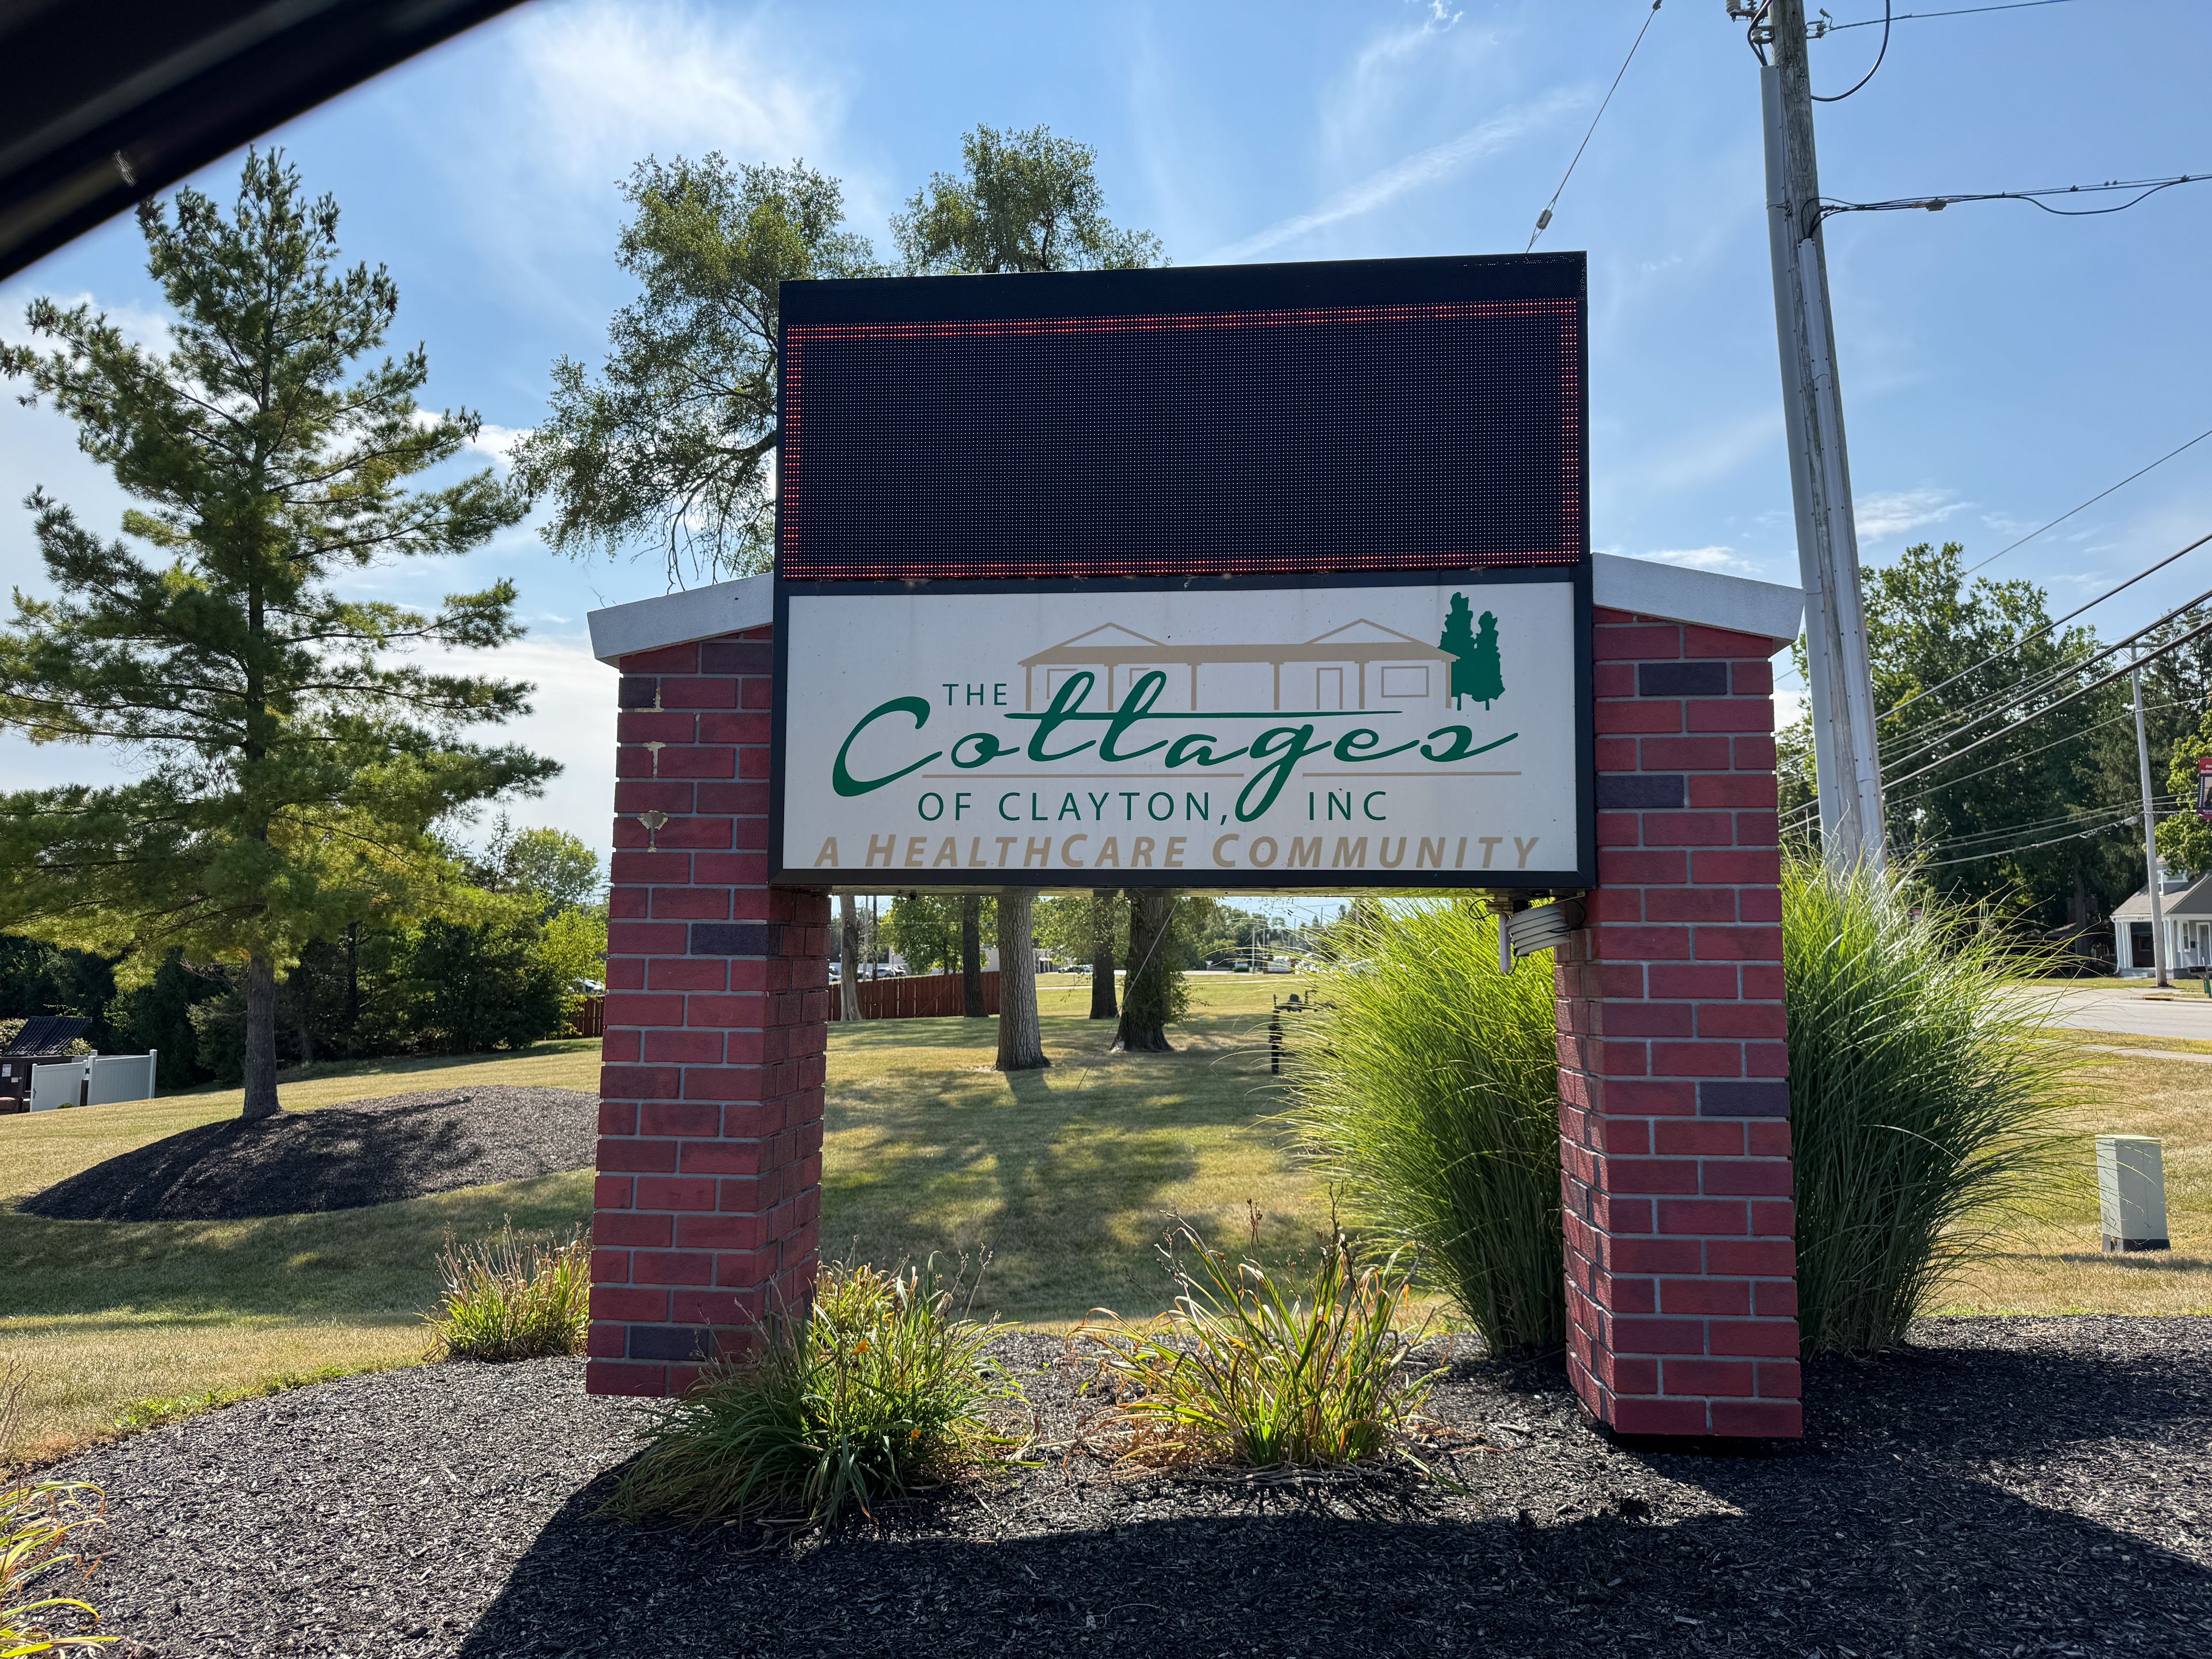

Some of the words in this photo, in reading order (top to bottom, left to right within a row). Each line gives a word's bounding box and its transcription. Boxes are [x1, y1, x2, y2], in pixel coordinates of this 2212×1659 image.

[943, 683, 1007, 706] THE
[832, 671, 1519, 823] Cottages
[918, 792, 972, 821] OF
[998, 792, 1227, 825] CLAYTON,
[1309, 791, 1387, 821] INC
[815, 837, 839, 868] A
[866, 834, 1186, 868] HEALTHCARE
[1213, 834, 1540, 868] COMMUNITY
